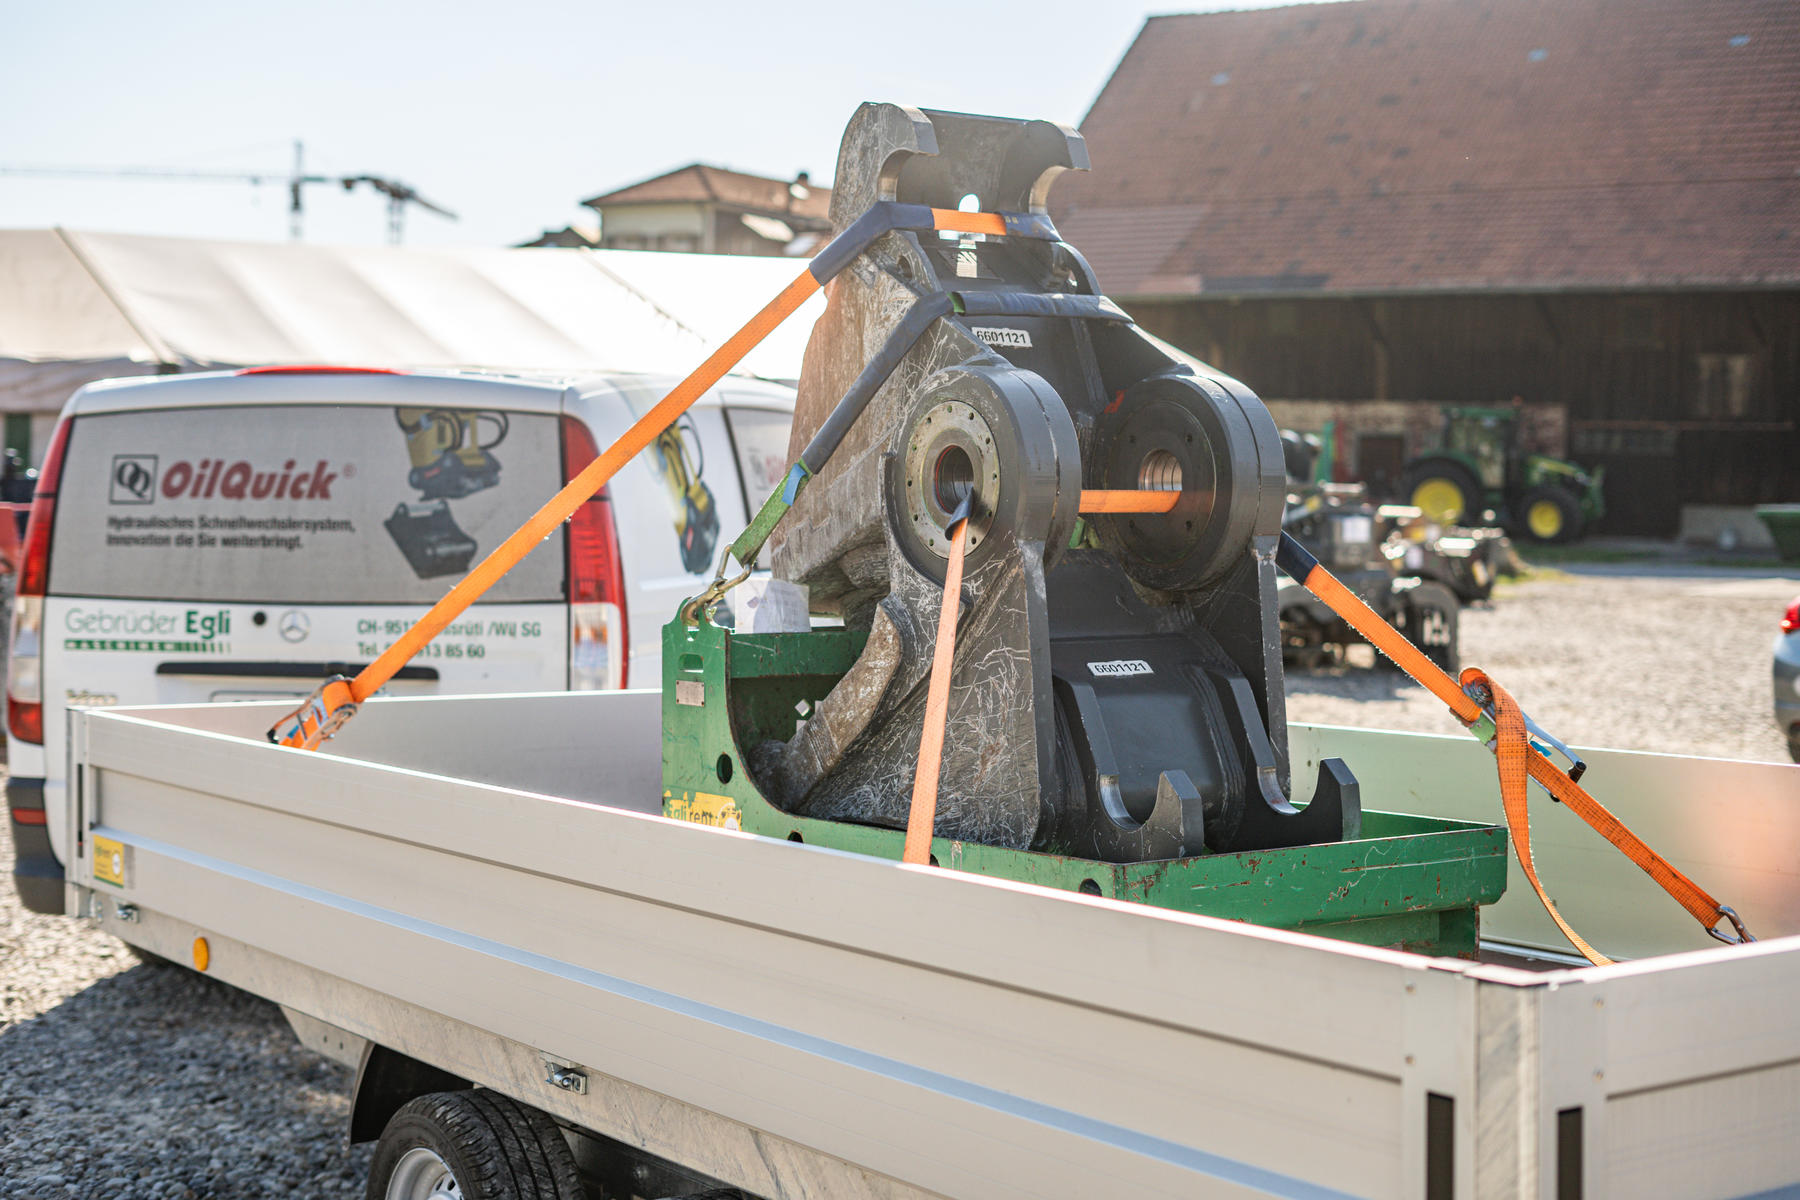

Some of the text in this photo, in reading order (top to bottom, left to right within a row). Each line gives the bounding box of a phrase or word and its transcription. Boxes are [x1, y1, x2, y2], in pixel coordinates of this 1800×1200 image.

[976, 330, 1026, 343] 6601121
[161, 459, 338, 500] OilQuick
[106, 534, 171, 547] Innovation
[175, 534, 193, 547] die
[199, 534, 216, 547] Sie
[65, 608, 231, 639] Gebrüder Egli
[521, 622, 541, 636] SG
[446, 646, 463, 657] 85
[467, 646, 485, 657] 60
[1094, 662, 1147, 673] 6601121
